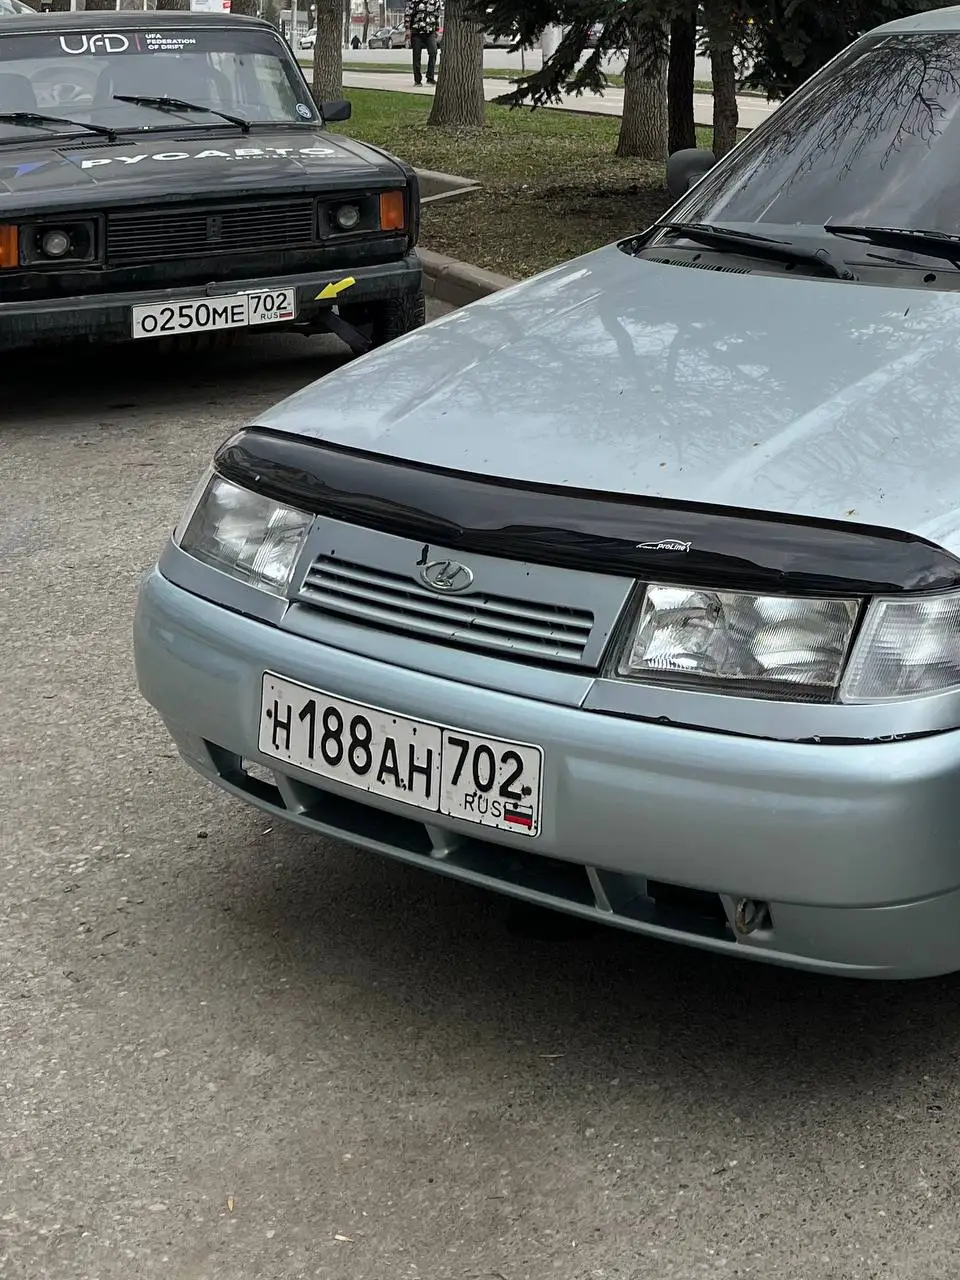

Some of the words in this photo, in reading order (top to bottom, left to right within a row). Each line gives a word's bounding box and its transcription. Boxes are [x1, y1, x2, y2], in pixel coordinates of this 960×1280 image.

[81, 148, 336, 169] РУСАВТО
[141, 303, 245, 333] О250МЕ
[250, 292, 288, 314] 702
[260, 311, 279, 320] RUS
[272, 698, 433, 798] Н188АН
[447, 736, 524, 801] 702
[463, 793, 502, 817] RUS
